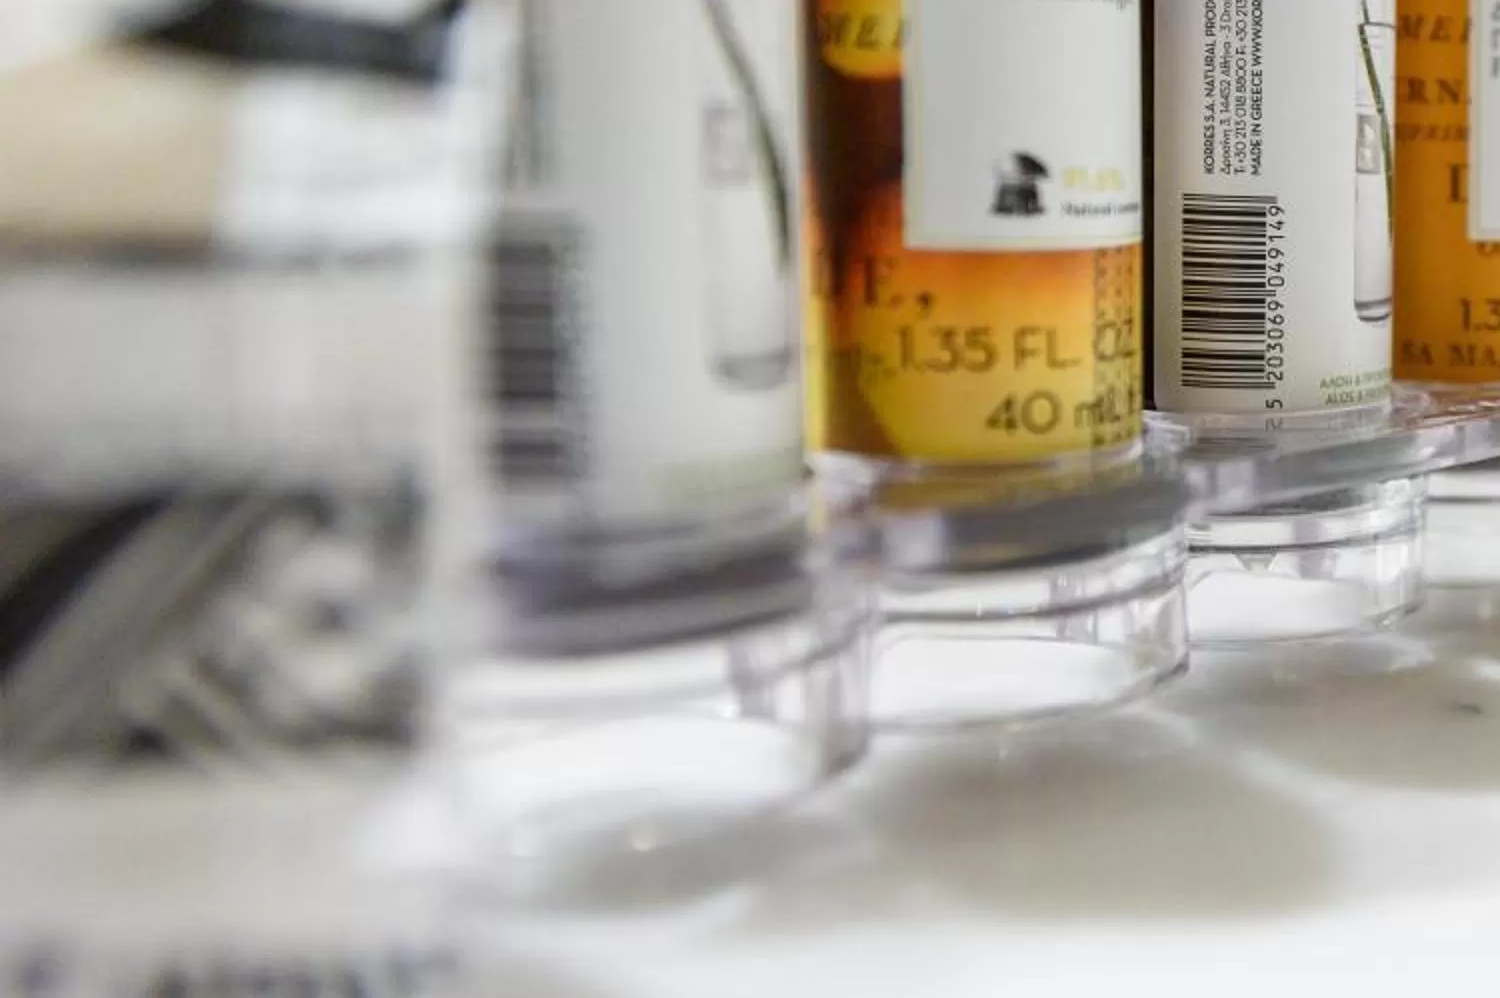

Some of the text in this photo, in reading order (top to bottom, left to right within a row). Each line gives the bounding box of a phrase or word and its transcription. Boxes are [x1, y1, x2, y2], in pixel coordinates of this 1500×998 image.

[1235, 20, 1247, 42] +30
[1203, 41, 1217, 97] NATURAL
[1235, 58, 1247, 92] 8800
[1203, 100, 1217, 122] S.A.
[1219, 80, 1231, 113] 14452
[1235, 95, 1247, 117] 018
[1250, 69, 1263, 120] GREECE
[1235, 120, 1247, 139] 213
[1250, 123, 1263, 136] IN
[1203, 125, 1217, 175] KORRES
[1235, 141, 1247, 163] +30
[1250, 139, 1263, 175] MADE
[1266, 204, 1286, 410] 5 203069 049149
[985, 390, 1064, 435] 40
